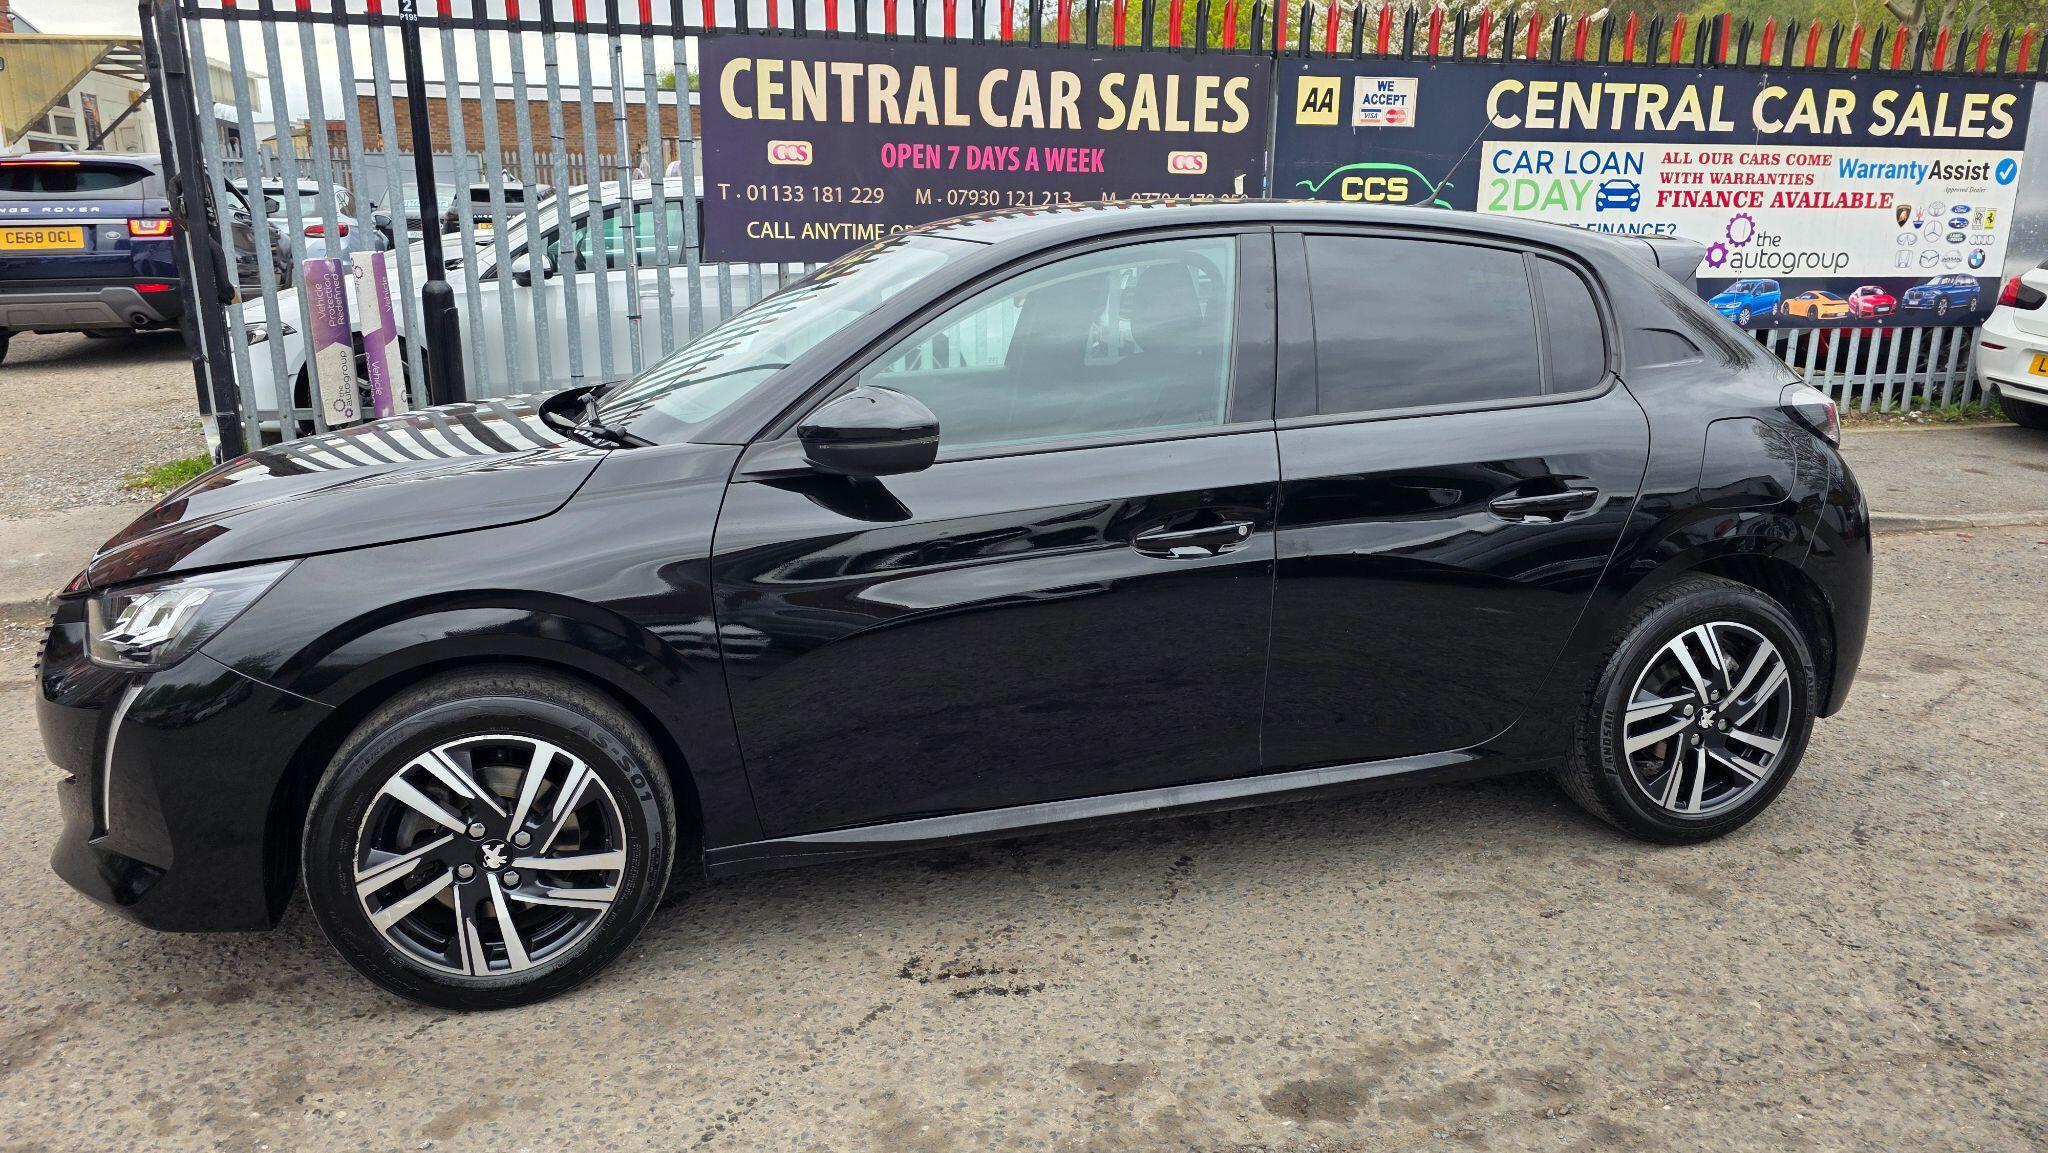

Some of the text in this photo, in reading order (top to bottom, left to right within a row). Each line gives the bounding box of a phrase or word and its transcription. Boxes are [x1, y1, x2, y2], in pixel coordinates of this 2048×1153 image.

[402, 0, 413, 12] 2
[719, 57, 1250, 134] CENTRAL CAR SALES
[1377, 81, 1395, 91] WE
[1301, 87, 1334, 113] AA
[1362, 94, 1407, 105] ACCEPT
[1486, 79, 2018, 139] CENTRAL CAR SALES
[773, 144, 809, 162] CCS
[881, 143, 1105, 173] OPEN 7 DAYS A WEEK
[1172, 154, 1203, 171] CCS
[1492, 149, 1645, 175] CAR LOAN
[1661, 151, 1833, 167] ALL OUR CARS COME
[1341, 176, 1409, 201] CCS
[1659, 172, 1815, 186] WITH WARRANTIES
[746, 184, 804, 202] 01133
[812, 186, 843, 202] 181
[851, 187, 885, 204] 229
[947, 189, 1000, 206] 07930
[1006, 191, 1033, 206] 121
[1042, 191, 1072, 206] 213
[1488, 178, 1594, 212] 2DAY
[1655, 190, 1894, 210] FINANCE AVAILABLE
[5, 230, 77, 244] CE68 OCL
[747, 221, 795, 239] CALL
[801, 222, 884, 241] ANYTIME
[1756, 230, 1781, 247] the
[1730, 246, 1850, 274] autogroup
[317, 283, 327, 320] Vehicle
[324, 273, 337, 327] Protection
[331, 273, 345, 326] Redefined
[340, 350, 353, 407] autogroup
[1603, 709, 1618, 776] LANDSAIL
